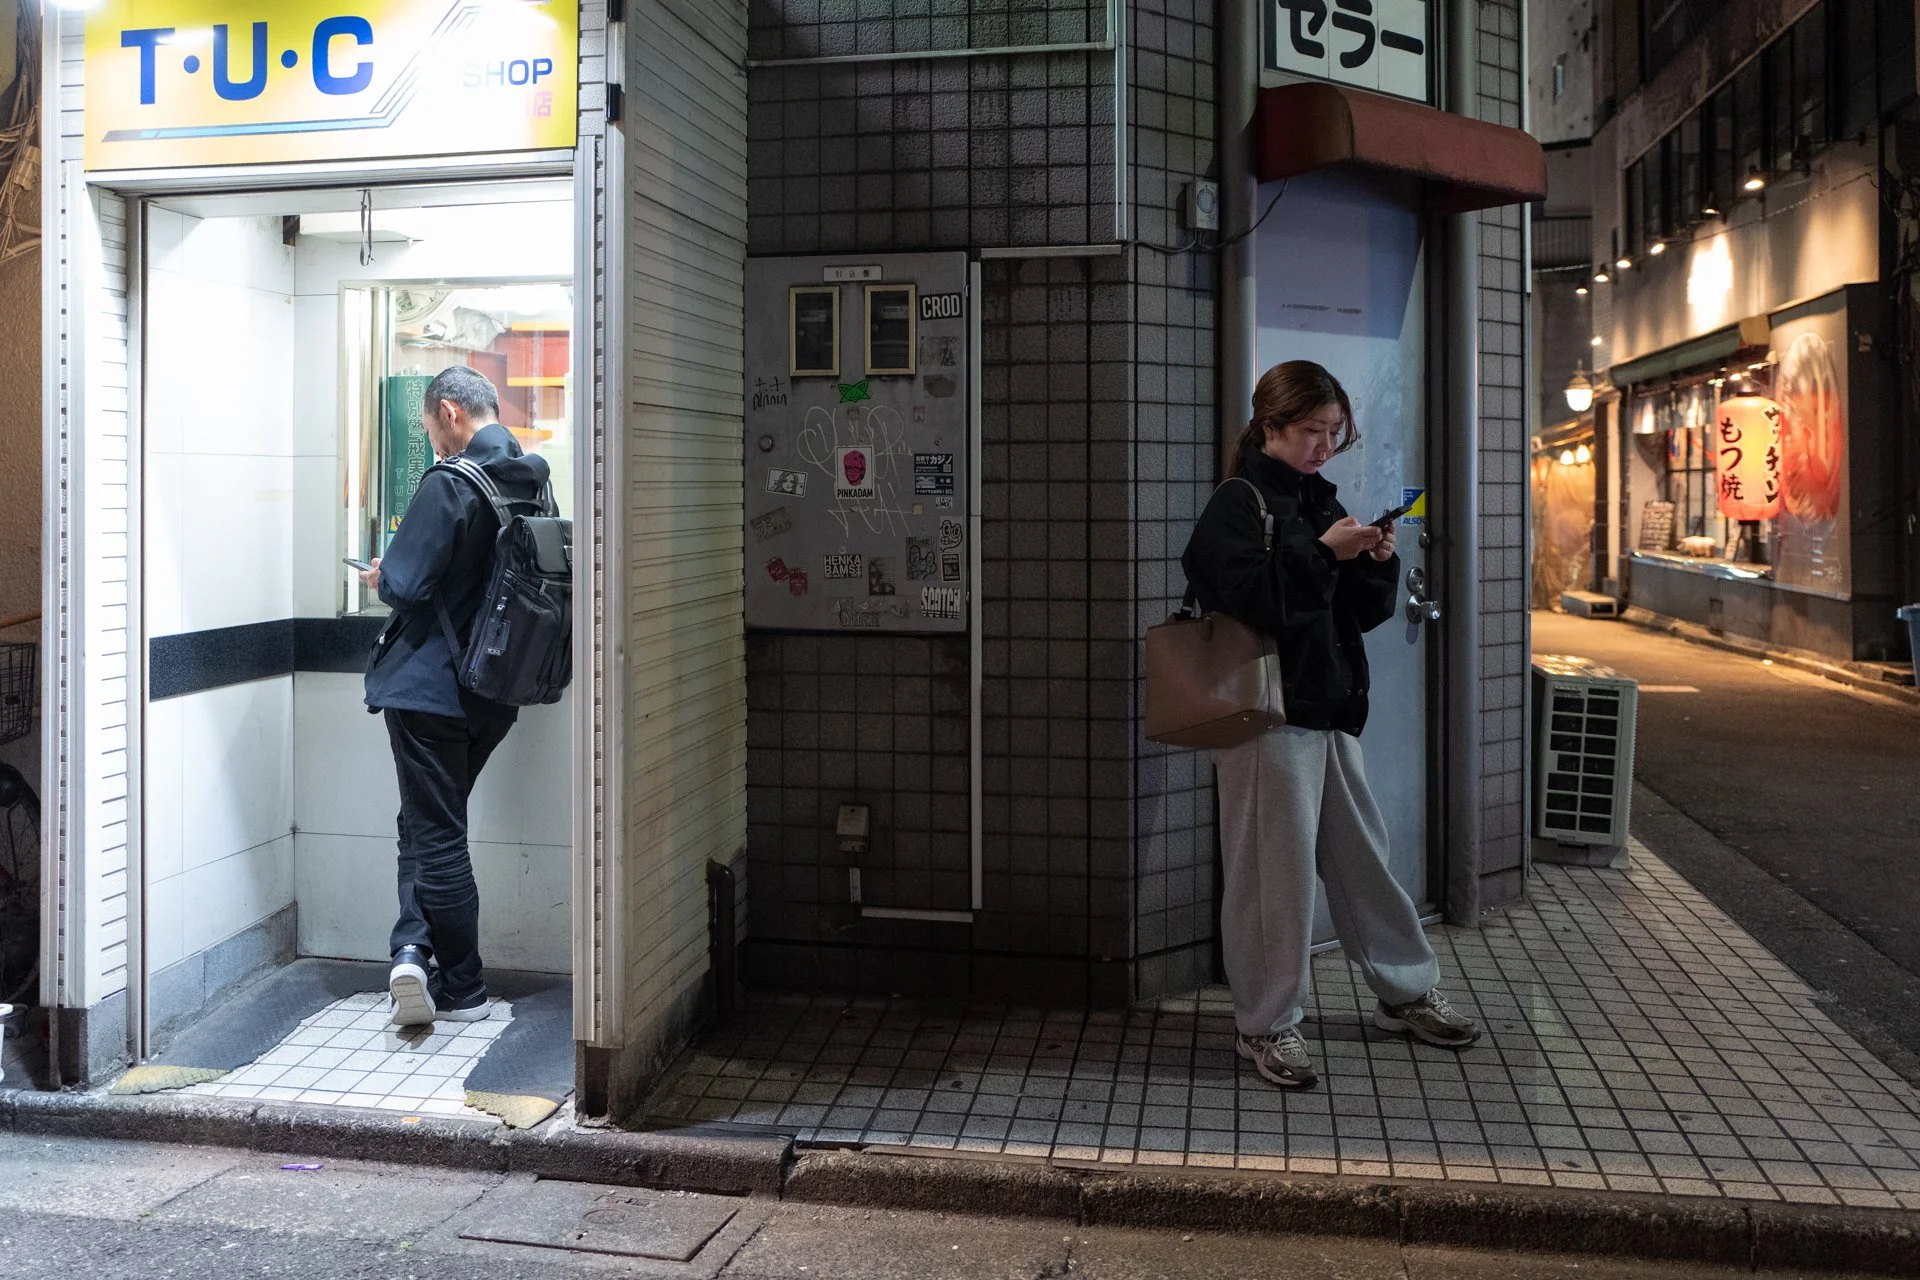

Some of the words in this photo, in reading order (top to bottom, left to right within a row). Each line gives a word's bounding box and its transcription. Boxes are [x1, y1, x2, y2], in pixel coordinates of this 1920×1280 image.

[1277, 0, 1424, 68] セラー
[462, 57, 553, 88] SHOP
[922, 294, 961, 319] CROD
[406, 380, 425, 506] 特別警戒実施
[1720, 417, 1744, 501] もつ焼
[837, 488, 873, 498] PINKADAM
[824, 555, 861, 565] HENKA
